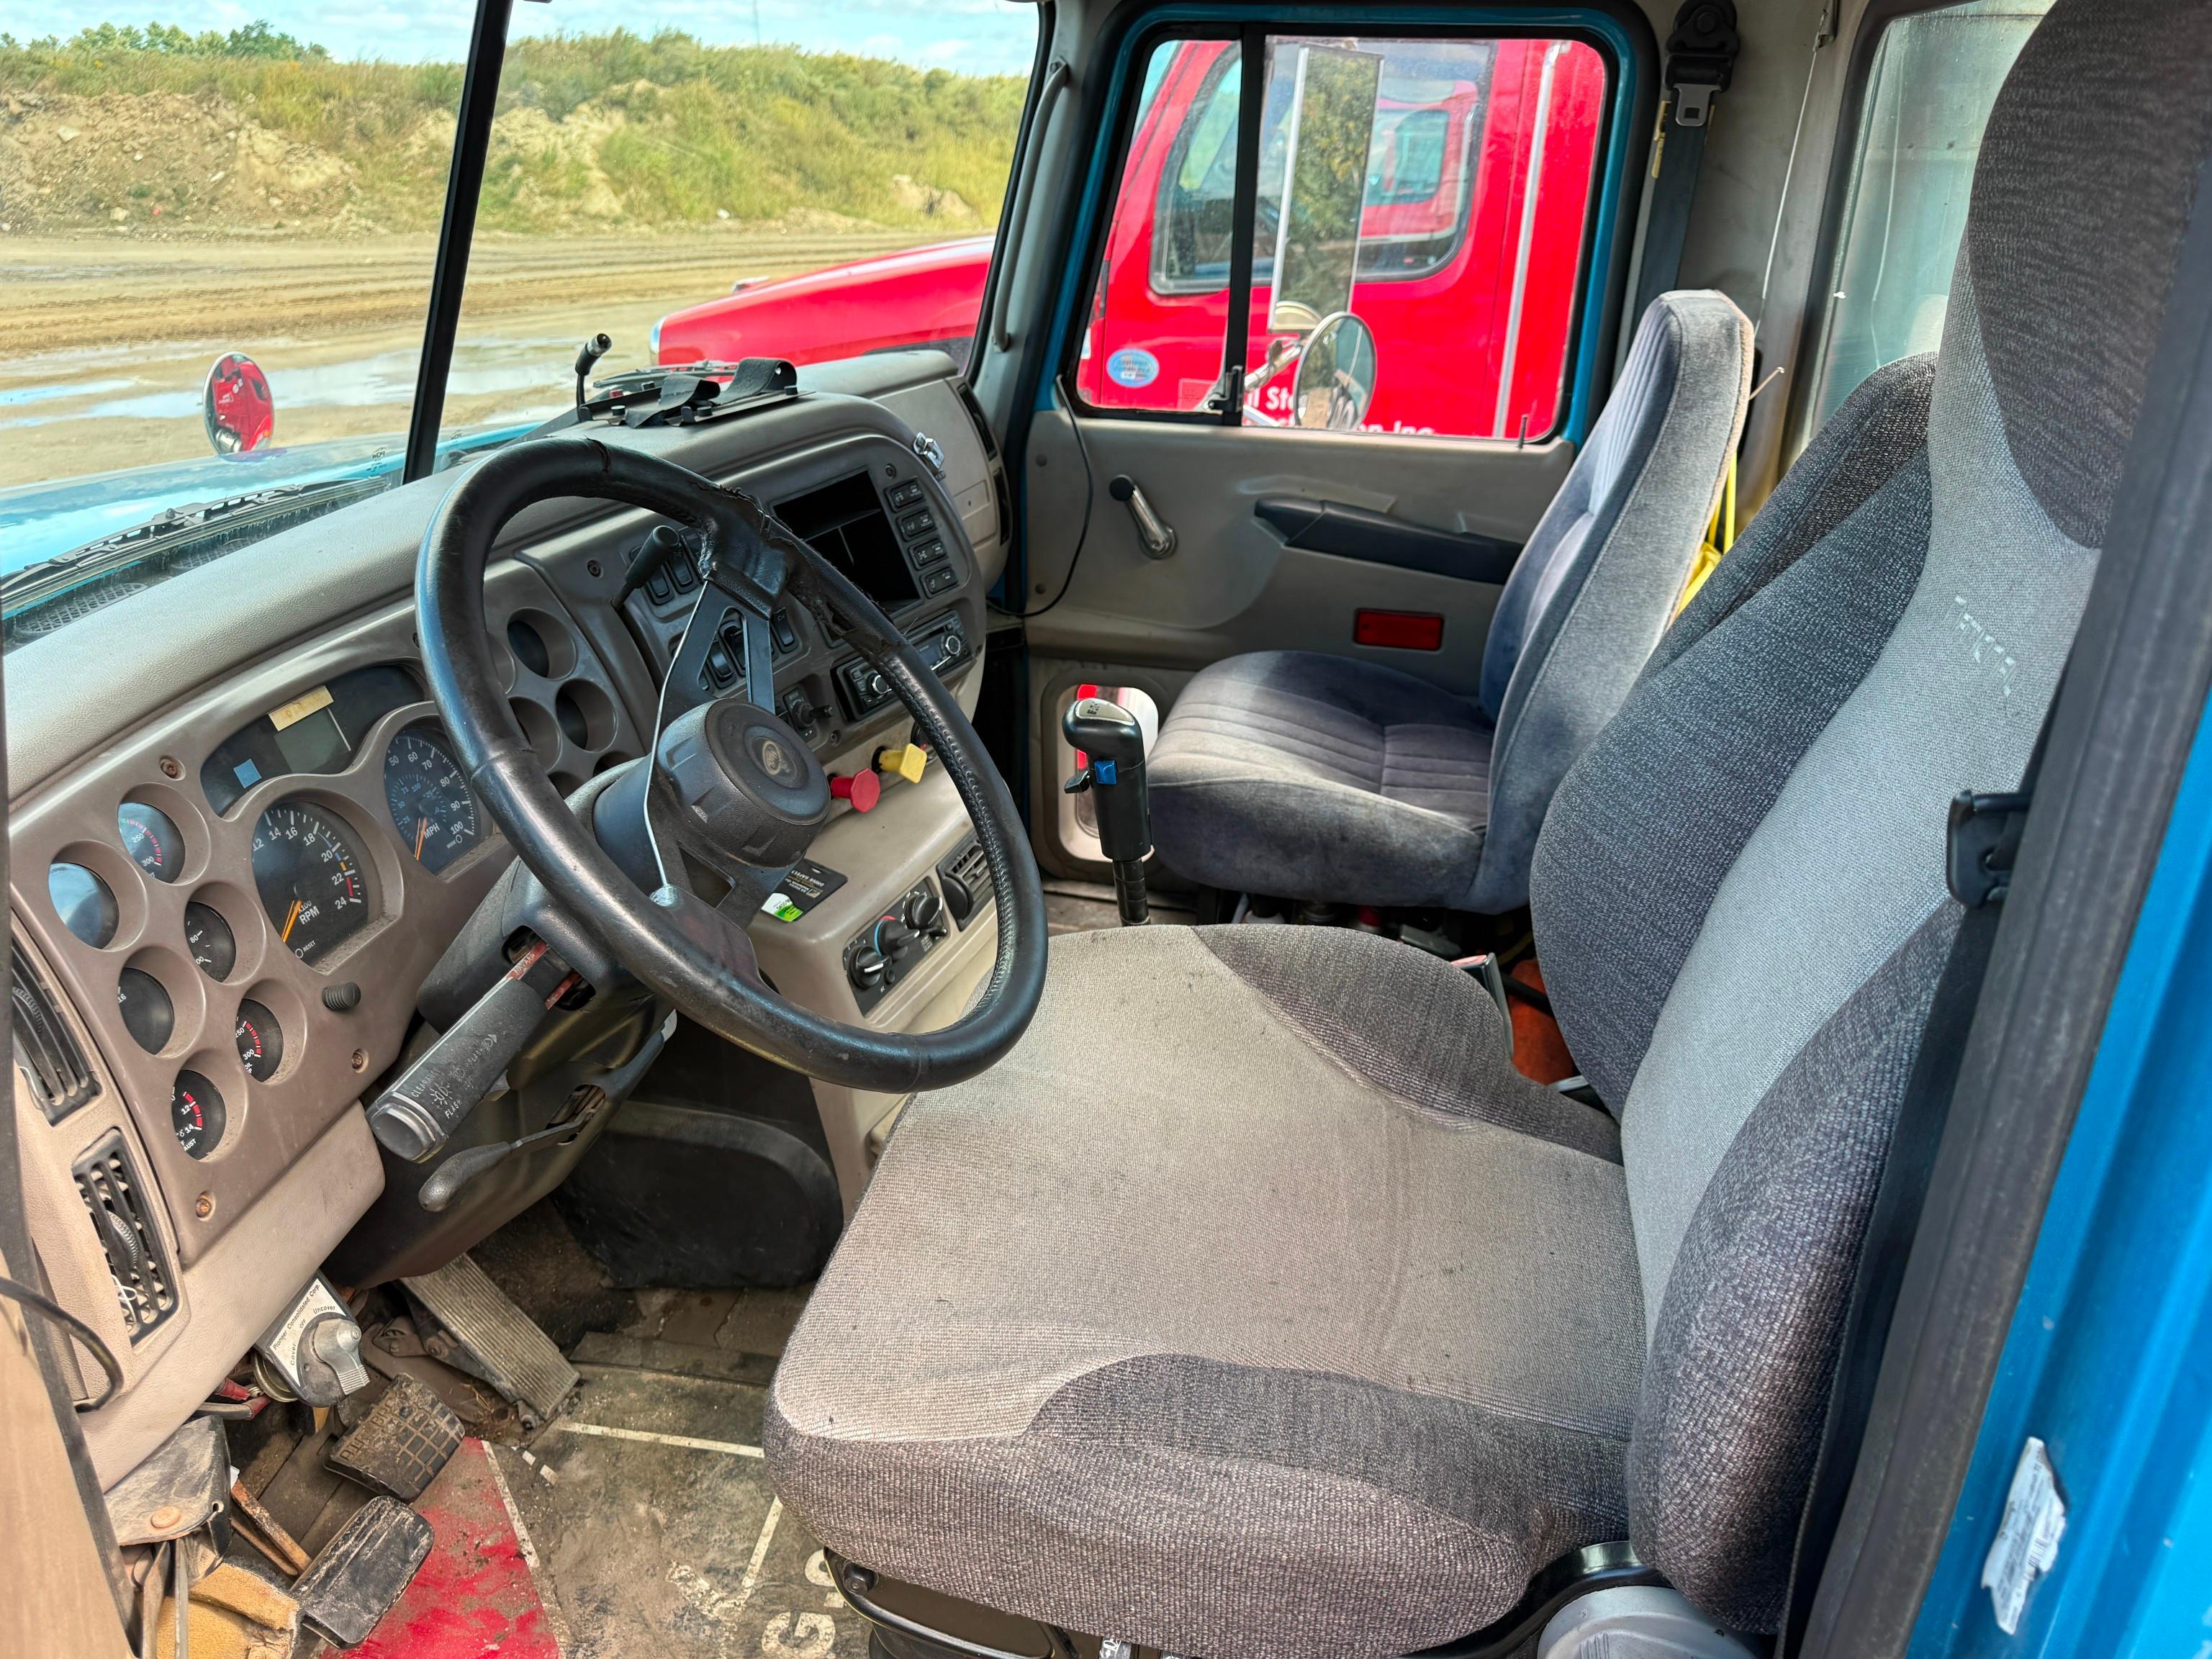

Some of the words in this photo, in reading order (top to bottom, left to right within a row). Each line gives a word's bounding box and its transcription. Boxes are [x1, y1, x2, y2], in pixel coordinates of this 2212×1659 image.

[388, 756, 399, 767] 50
[407, 751, 418, 762] 60
[422, 759, 433, 770] 70
[440, 777, 450, 787] 80
[451, 800, 461, 811] 90
[286, 827, 298, 840] 16
[424, 823, 440, 839] MPH
[450, 821, 464, 835] 100
[132, 833, 144, 844] 250
[268, 827, 281, 841] 14
[303, 833, 315, 846] 18
[143, 856, 154, 867] 300
[321, 850, 333, 863] 20
[332, 872, 344, 885] 22
[335, 897, 347, 910] 24
[299, 905, 320, 925] RPM
[190, 935, 199, 944] 80
[303, 940, 316, 952] RESET
[195, 956, 204, 964] 00
[243, 1049, 255, 1060] 300
[181, 1105, 191, 1116] 12
[185, 1124, 194, 1134] 14
[184, 1139, 197, 1152] AUST
[287, 1297, 310, 1329] Consolidated
[310, 1284, 320, 1298] Corp.
[312, 1306, 335, 1314] Uncover
[299, 1319, 307, 1329] OFF
